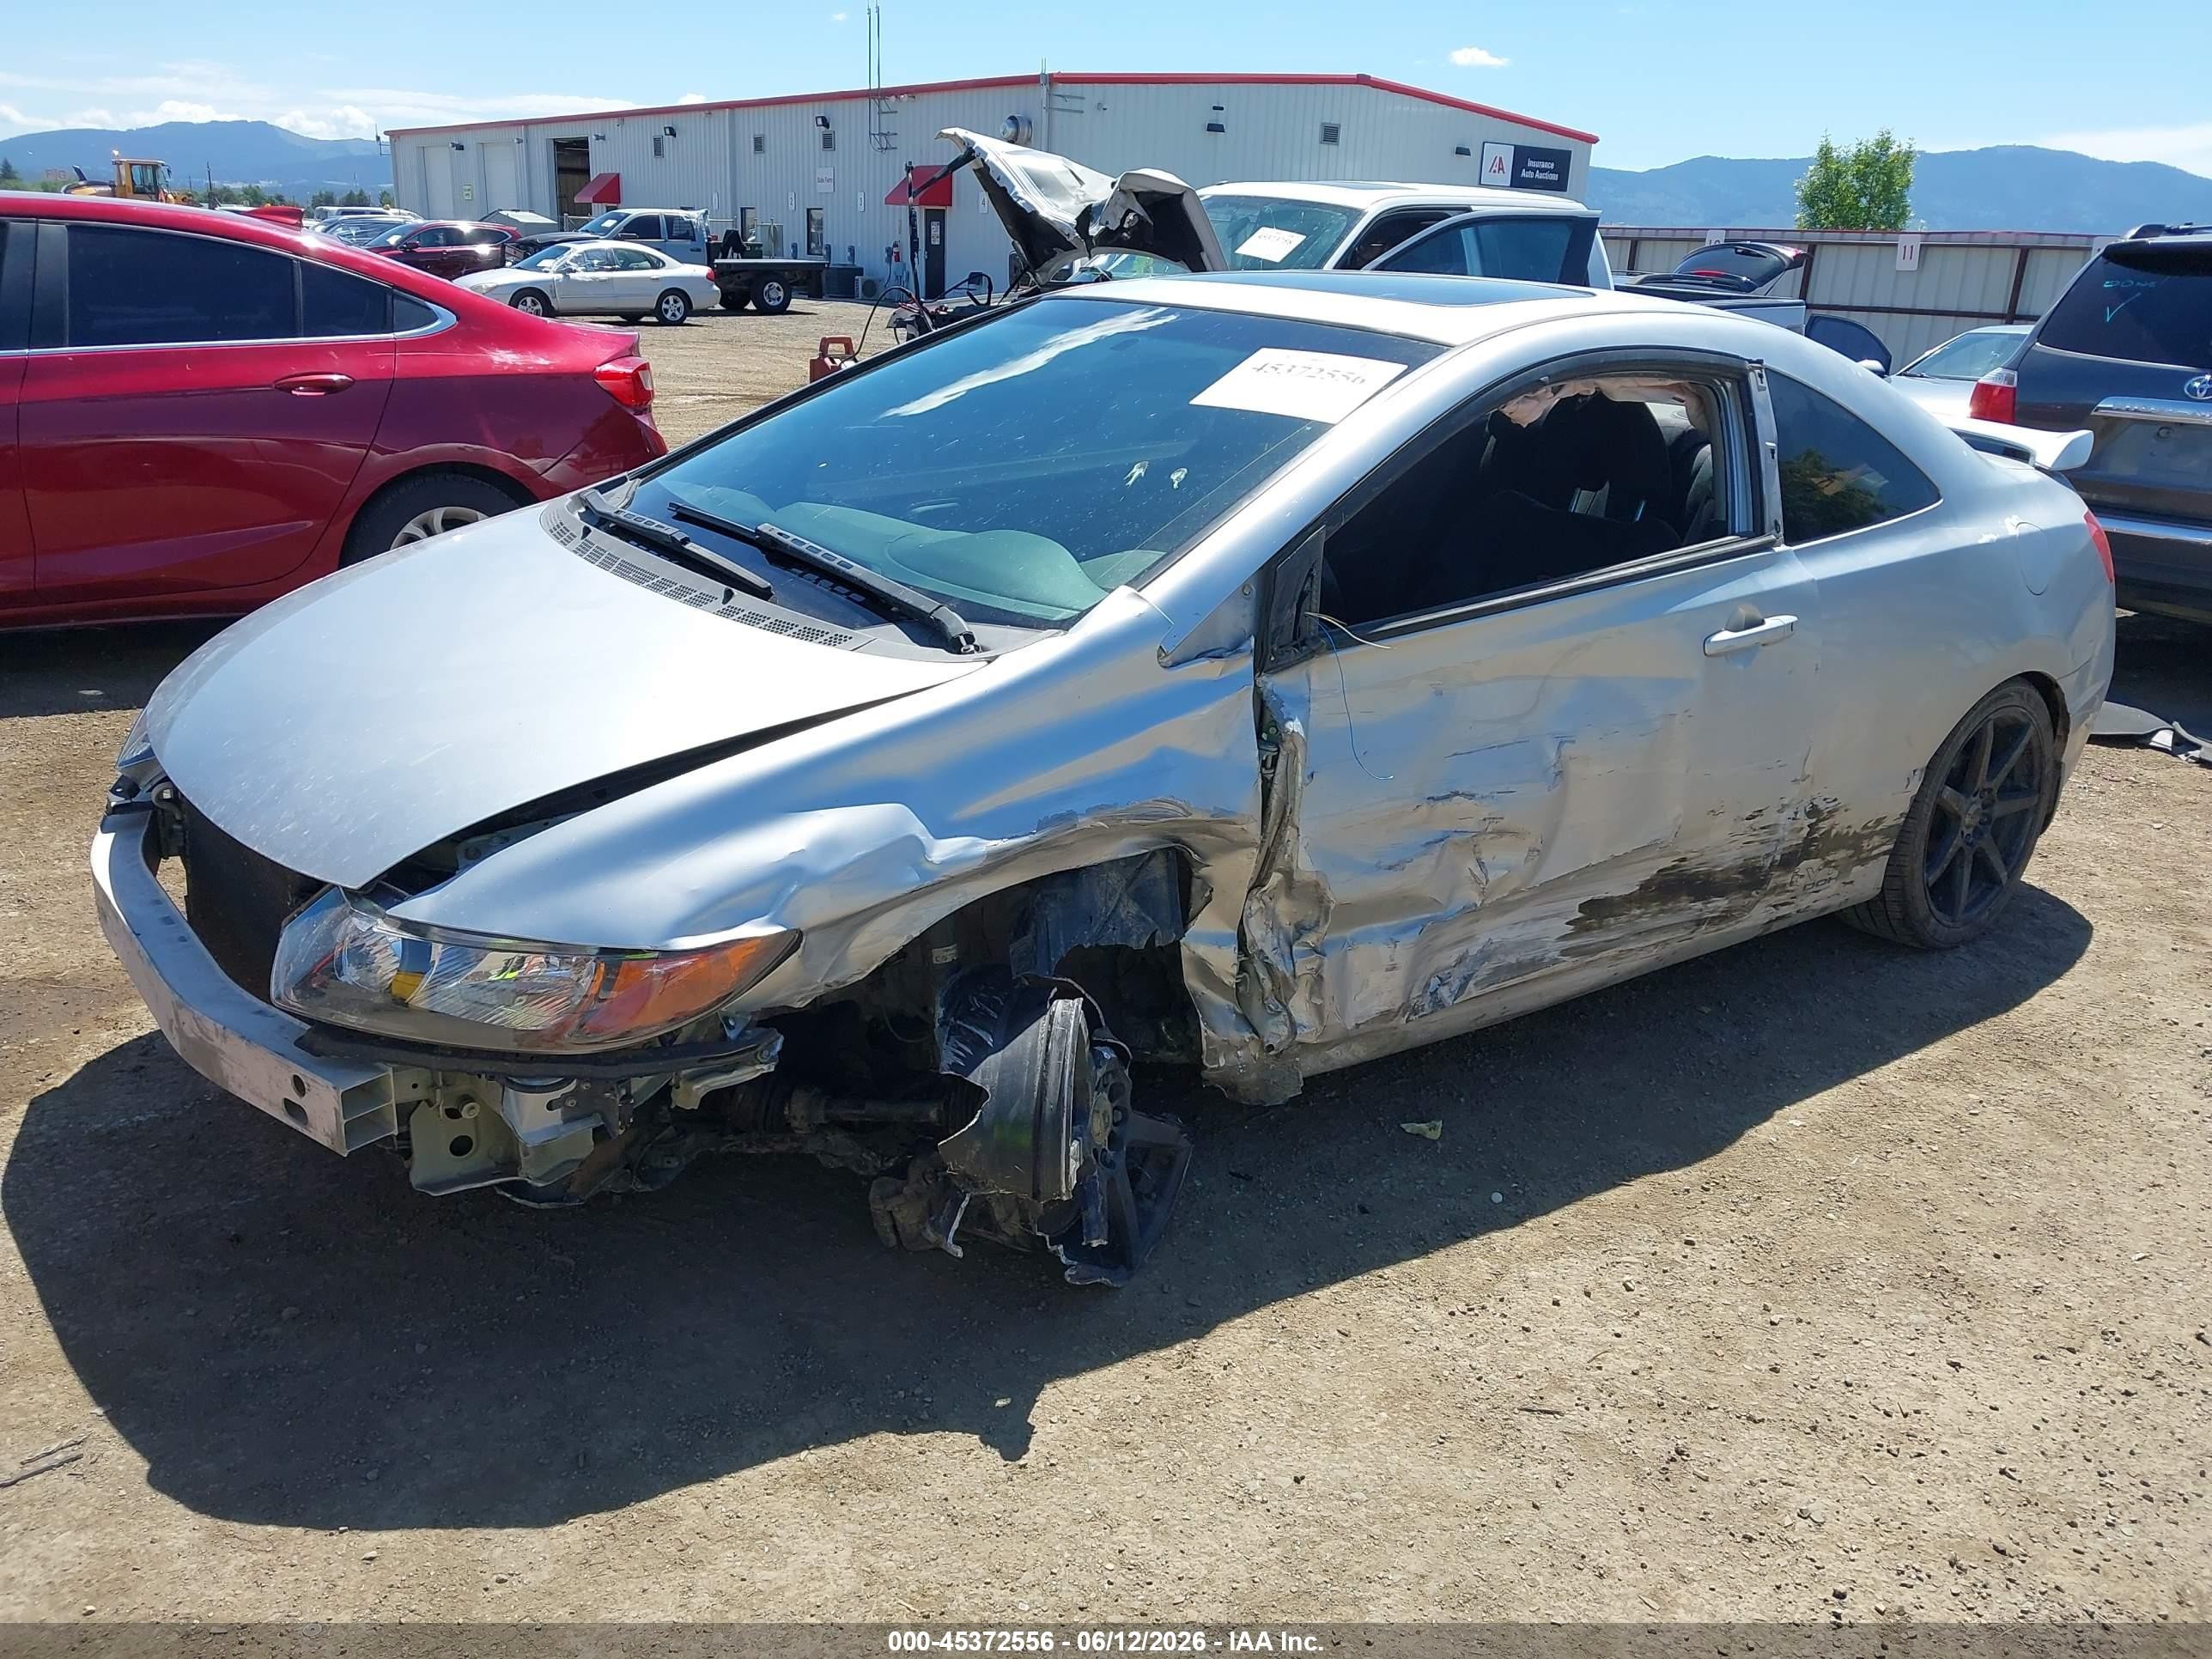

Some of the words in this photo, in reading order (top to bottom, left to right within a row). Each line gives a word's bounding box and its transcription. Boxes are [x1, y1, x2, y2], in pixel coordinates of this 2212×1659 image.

[1528, 158, 1555, 169] Insurance
[1521, 168, 1534, 178] Auto
[1534, 170, 1559, 181] Auctions
[1903, 245, 1913, 260] 11
